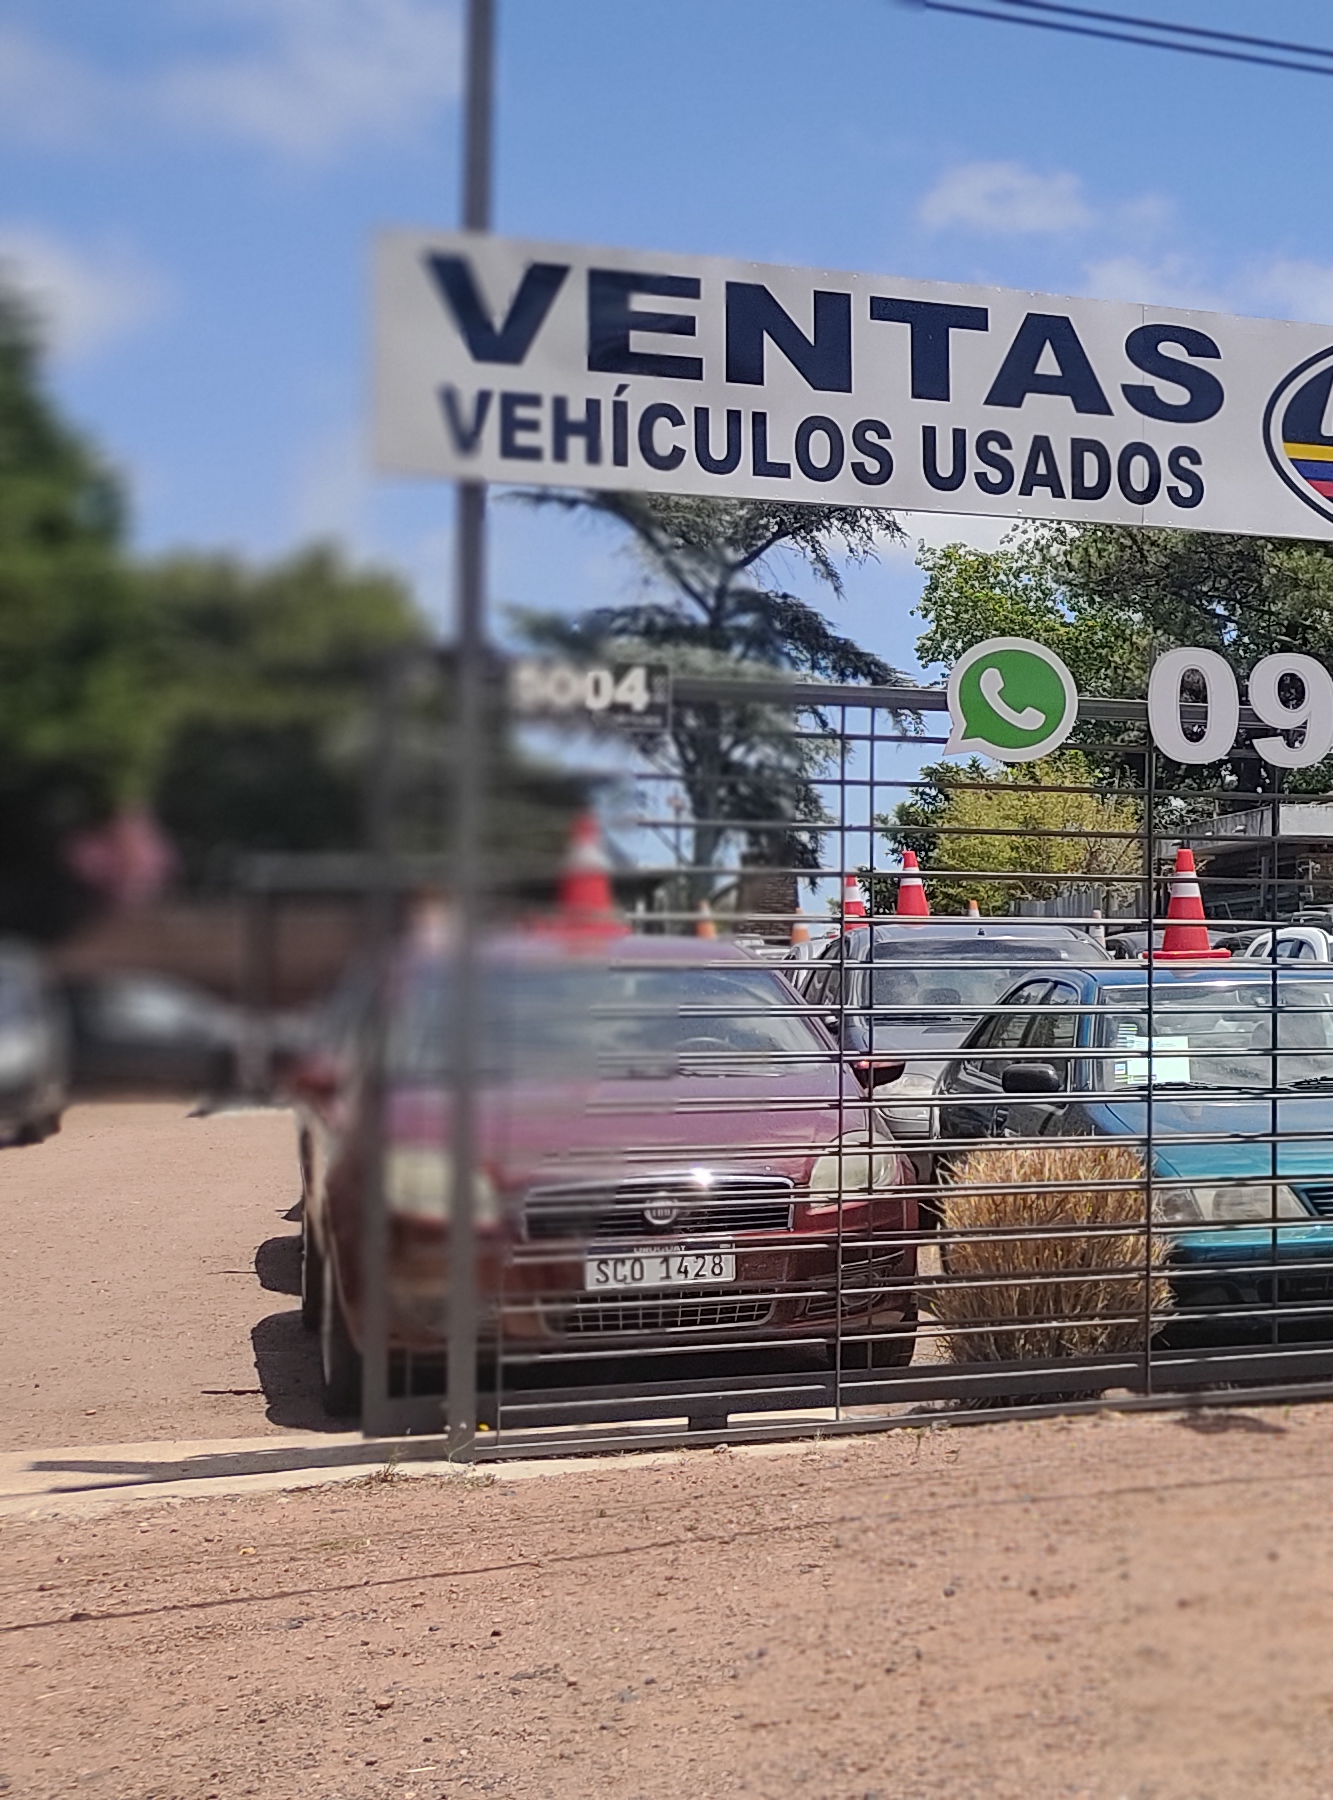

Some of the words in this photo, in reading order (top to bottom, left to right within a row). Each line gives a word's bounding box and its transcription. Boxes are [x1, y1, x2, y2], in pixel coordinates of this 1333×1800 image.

[424, 249, 1226, 424] VENTAS
[438, 384, 895, 487] VEHÍCULOS
[922, 424, 1206, 510] USADOS
[514, 661, 650, 712] 004
[595, 1258, 645, 1284] SCO
[659, 1254, 724, 1280] 1428
